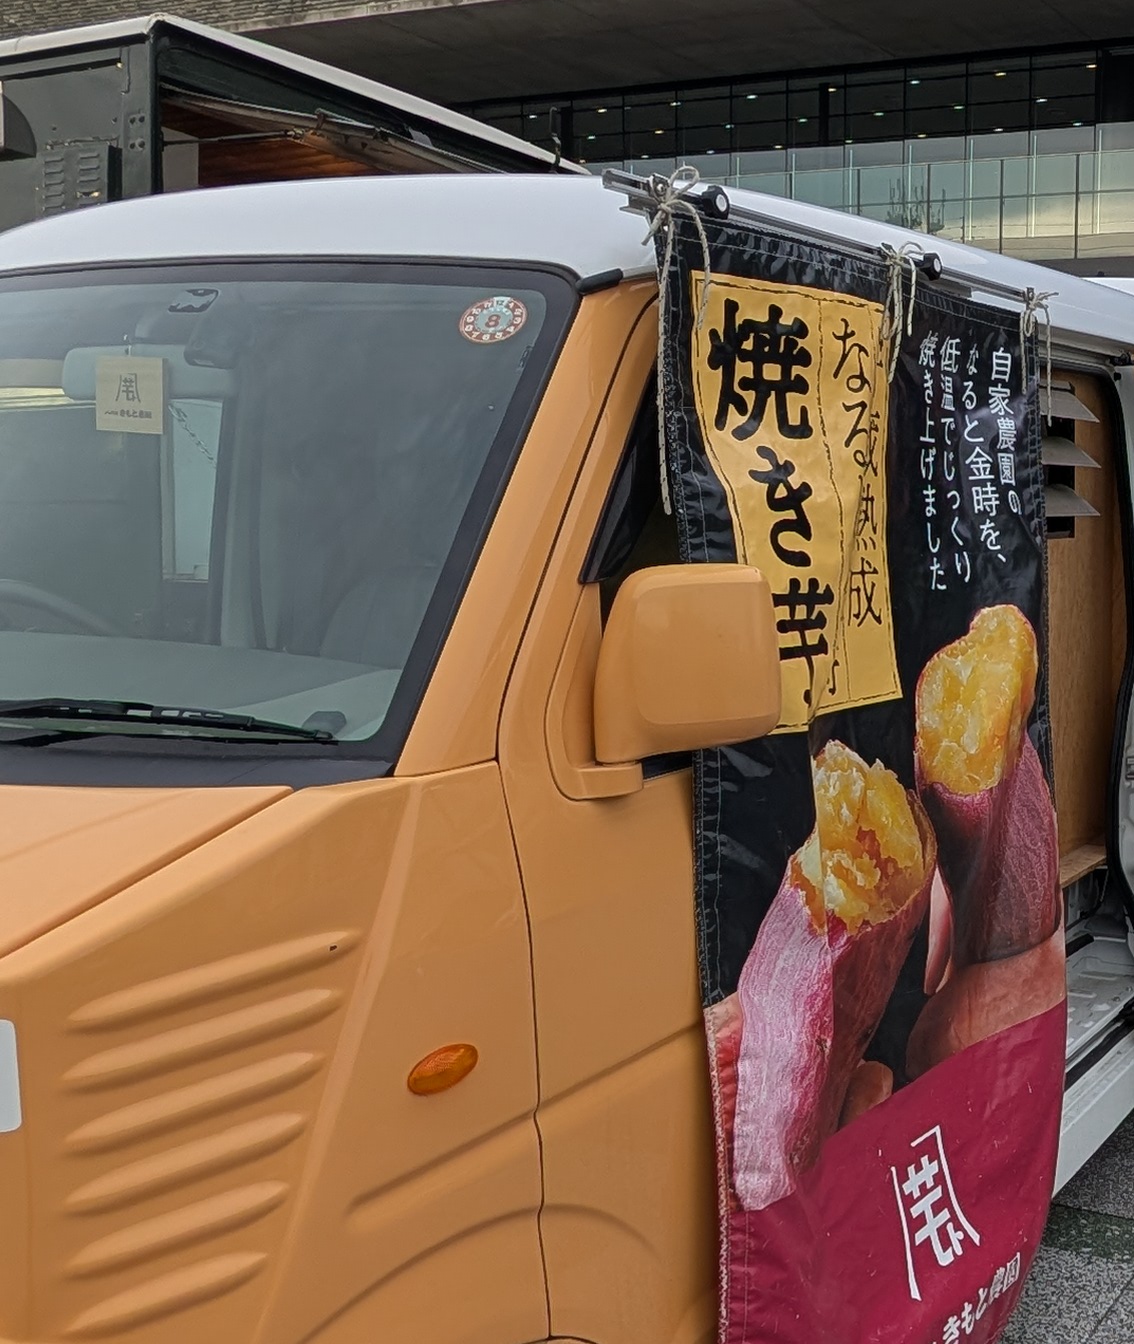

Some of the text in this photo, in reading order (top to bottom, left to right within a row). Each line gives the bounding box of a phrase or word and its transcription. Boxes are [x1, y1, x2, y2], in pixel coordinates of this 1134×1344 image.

[707, 298, 835, 706] 焼き芋
[918, 330, 947, 590] 焼き上げました
[940, 336, 971, 583] 低温でじっくり
[962, 343, 1006, 563] なると金時、
[988, 347, 1022, 515] 自家農園の
